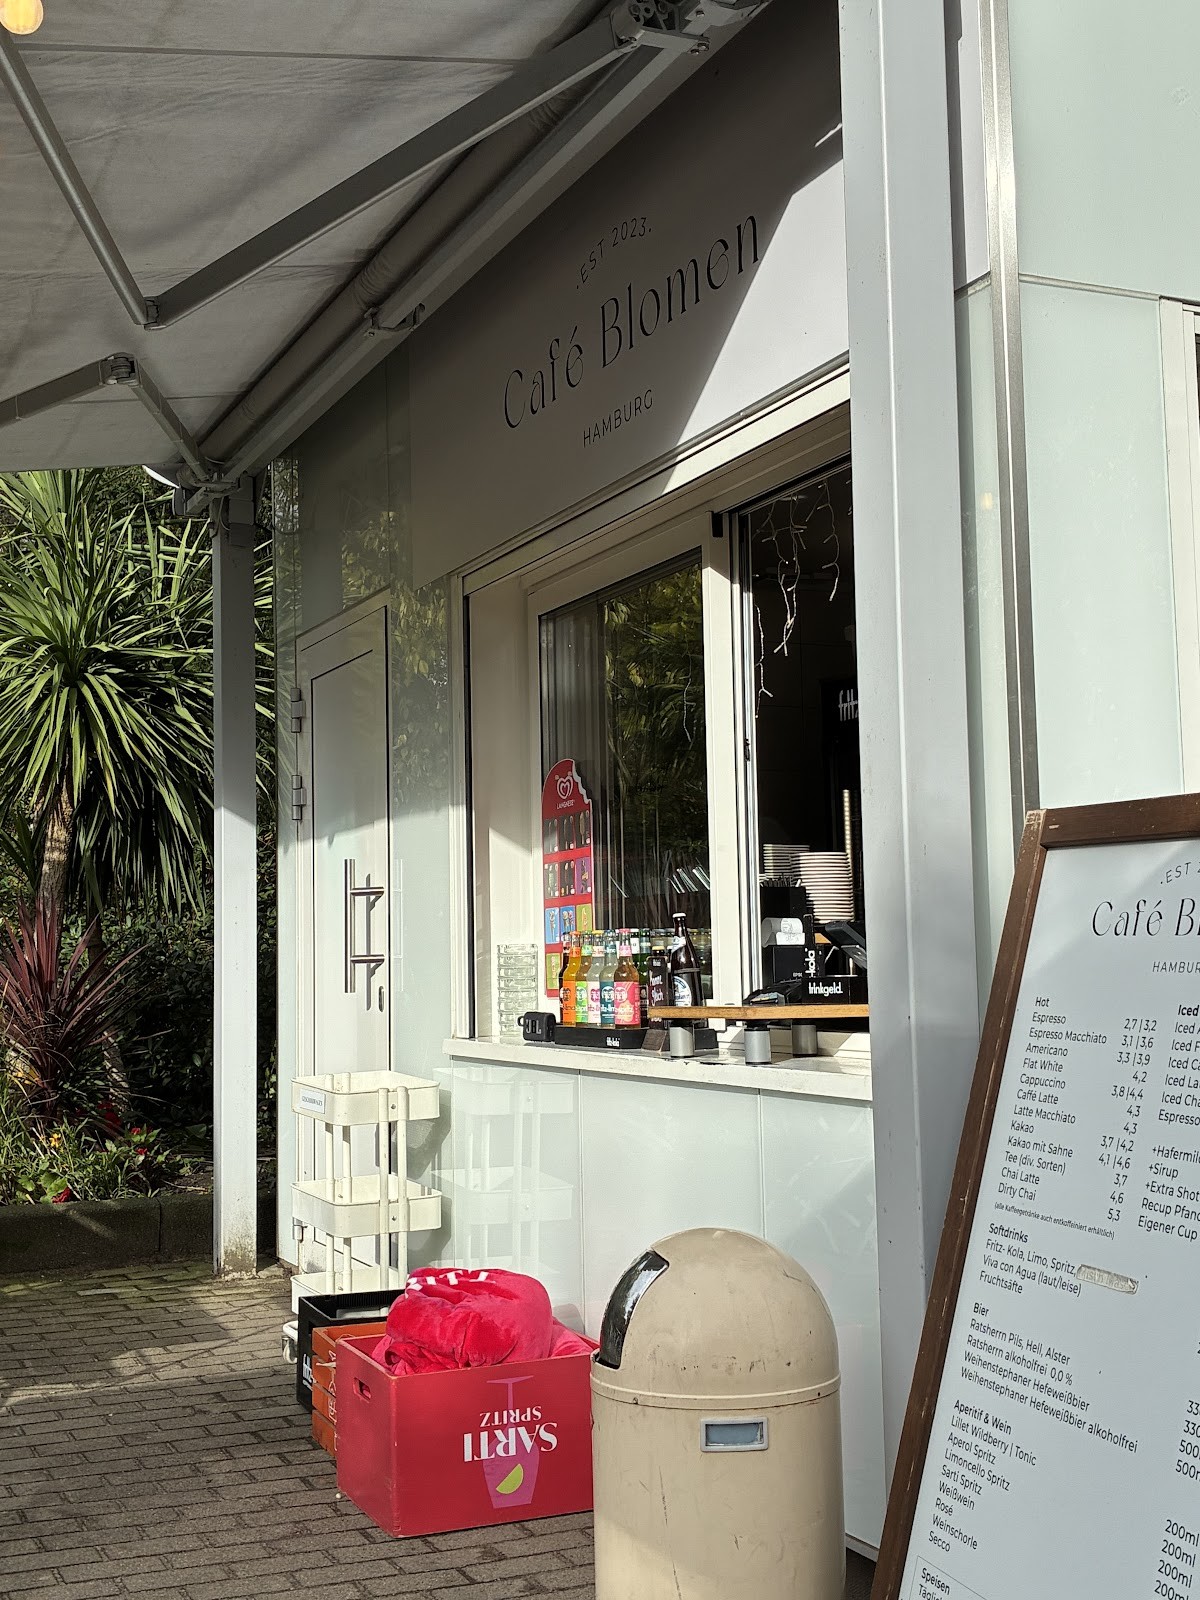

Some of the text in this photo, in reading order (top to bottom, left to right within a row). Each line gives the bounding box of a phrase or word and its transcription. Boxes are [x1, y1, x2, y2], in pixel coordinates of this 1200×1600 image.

[504, 215, 759, 429] Café Blomen
[582, 389, 654, 449] HAMBURG
[1092, 898, 1200, 937] Café B
[1035, 997, 1050, 1007] Hot
[1178, 1004, 1200, 1017] Iced
[1032, 1012, 1067, 1024] Espresso
[1174, 1021, 1196, 1034] Iced
[1029, 1027, 1063, 1040] Espresso
[1065, 1030, 1107, 1044] Macchiato
[1171, 1039, 1192, 1052] Iced
[1025, 1043, 1068, 1056] Americano
[1168, 1056, 1189, 1069] Iced
[1020, 1073, 1066, 1089] Cappuccino
[1023, 1058, 1147, 1084] Flat White 4,2
[1165, 1073, 1186, 1087] Iced
[1038, 1092, 1059, 1104] Latte
[1126, 1104, 1141, 1118] 4,3
[1161, 1091, 1183, 1105] Iced
[1010, 1119, 1035, 1134] Kakao
[1013, 1104, 1138, 1135] Latte Macchiato 4,3
[1158, 1108, 1200, 1125] Espresso
[1007, 1135, 1031, 1150] Kakao
[1032, 1141, 1047, 1153] mit
[1047, 1143, 1074, 1158] Sahne
[1152, 1145, 1200, 1164] +Hafermil
[1004, 1150, 1128, 1188] Tee (div. Sorten) 3,7
[1001, 1166, 1124, 1205] Chai Latte 4,6
[1176, 1186, 1200, 1202] Shot
[998, 1182, 1121, 1223] Dirty Chai 5,3
[1141, 1197, 1172, 1217] Recup
[988, 1222, 1029, 1243] Softdrinks
[1138, 1215, 1198, 1242] Eigener Cup
[1006, 1244, 1025, 1262] Kola,
[1027, 1251, 1049, 1269] Limo,
[1050, 1257, 1077, 1277] Spritz,
[979, 1270, 1023, 1294] Fruchtsäfte
[983, 1254, 999, 1269] Viva
[999, 1261, 1014, 1274] con
[1015, 1265, 1037, 1281] Agua
[1038, 1270, 1082, 1298] (laut/leise)
[973, 1302, 990, 1317] Bier
[969, 1318, 1071, 1366] Ratsherrn Pils, Hell, Alster
[966, 1334, 1073, 1386] Ratsherrn alkoholfrei 0,0 %
[964, 1350, 1090, 1412] Weihenstephaner Hefeweißbier
[479, 1405, 542, 1428] SPRITZ
[953, 1399, 1012, 1435] Aperitif & Wein
[961, 1366, 1138, 1453] Weihenstephaner Hefeweißbier alkoholfrei
[463, 1422, 559, 1463] SARTI
[947, 1431, 996, 1465] Aperol Spritz
[951, 1415, 969, 1433] Lillet
[971, 1423, 1009, 1454] Wildberry
[1015, 1445, 1037, 1466] Tonic
[941, 1464, 983, 1496] Sarti Spritz
[944, 1448, 1011, 1491] Limoncello Spritz
[935, 1497, 954, 1517] Rosé
[939, 1480, 975, 1510] Weißwein
[929, 1531, 951, 1552] Secco
[932, 1514, 978, 1550] Weinschorle
[1165, 1519, 1200, 1547] 200ml
[1161, 1539, 1196, 1568] 200ml
[921, 1567, 951, 1595] Speisen
[1158, 1559, 1193, 1588] 200ml
